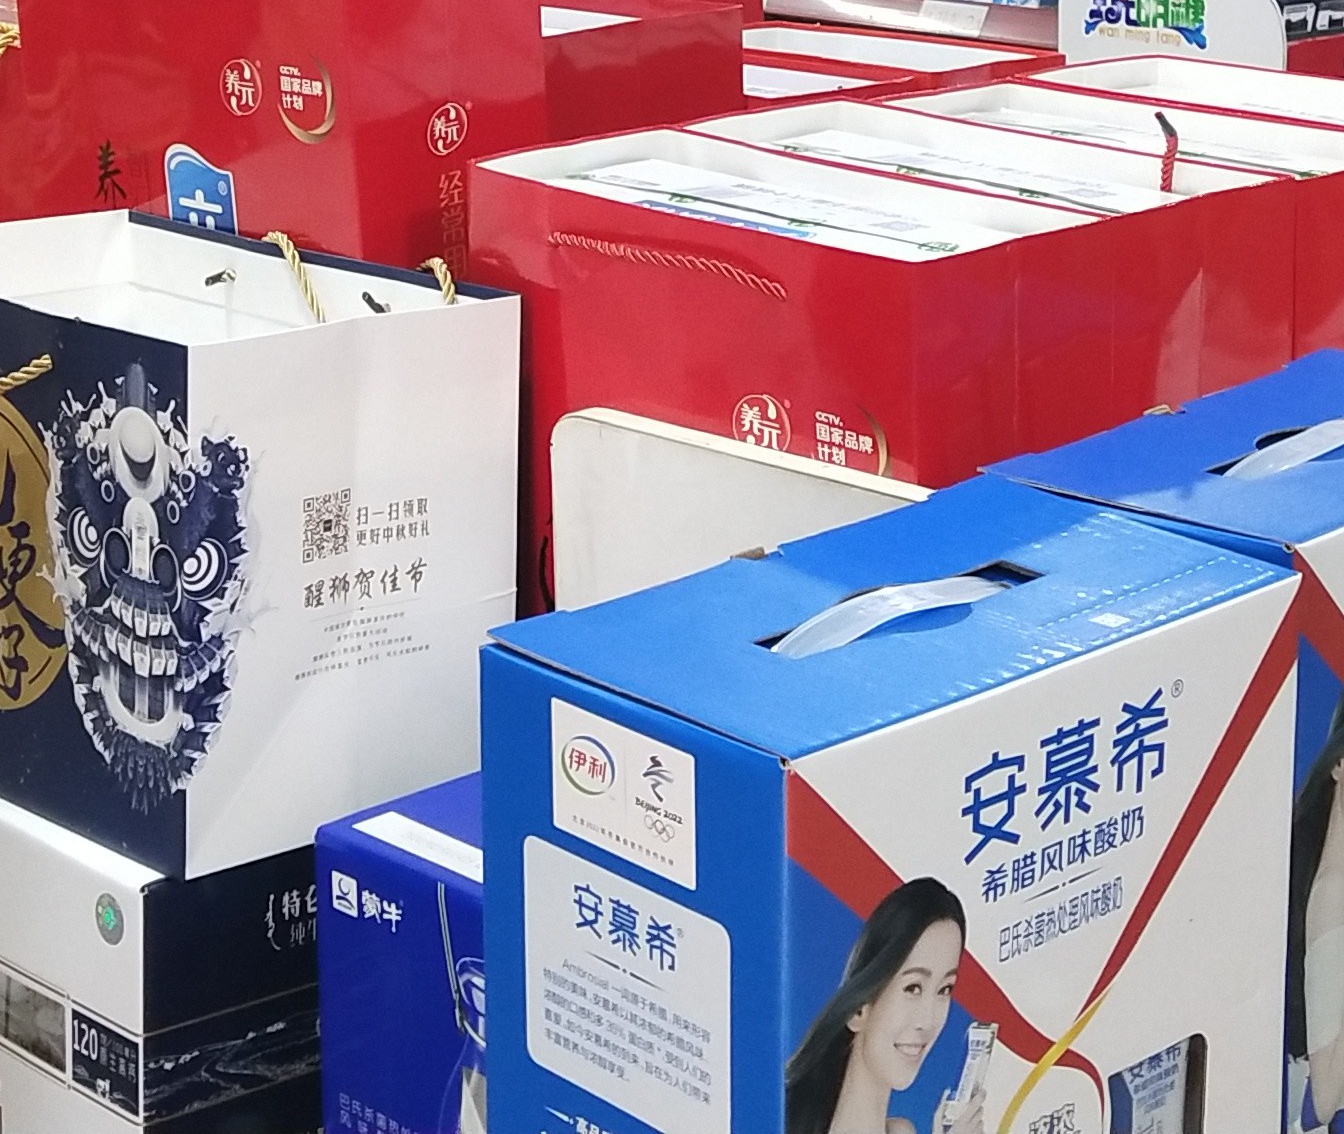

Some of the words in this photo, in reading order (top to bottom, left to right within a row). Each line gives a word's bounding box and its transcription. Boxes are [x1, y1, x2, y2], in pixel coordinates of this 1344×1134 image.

[279, 76, 324, 99] 国家品牌
[280, 93, 304, 113] 计划
[815, 422, 875, 456] 国家品牌
[356, 497, 429, 526] 扫一扫领取
[356, 519, 430, 548] 更好中秋好礼
[303, 556, 429, 609] 醒狮贺佳节
[567, 747, 608, 786] 伊利
[960, 686, 1171, 867] 安慕希
[662, 809, 685, 827] 2022
[980, 805, 1145, 905] 希腊风味酸奶
[360, 889, 402, 933] 蒙牛
[572, 883, 678, 973] 安慕希
[71, 1016, 99, 1060] 120
